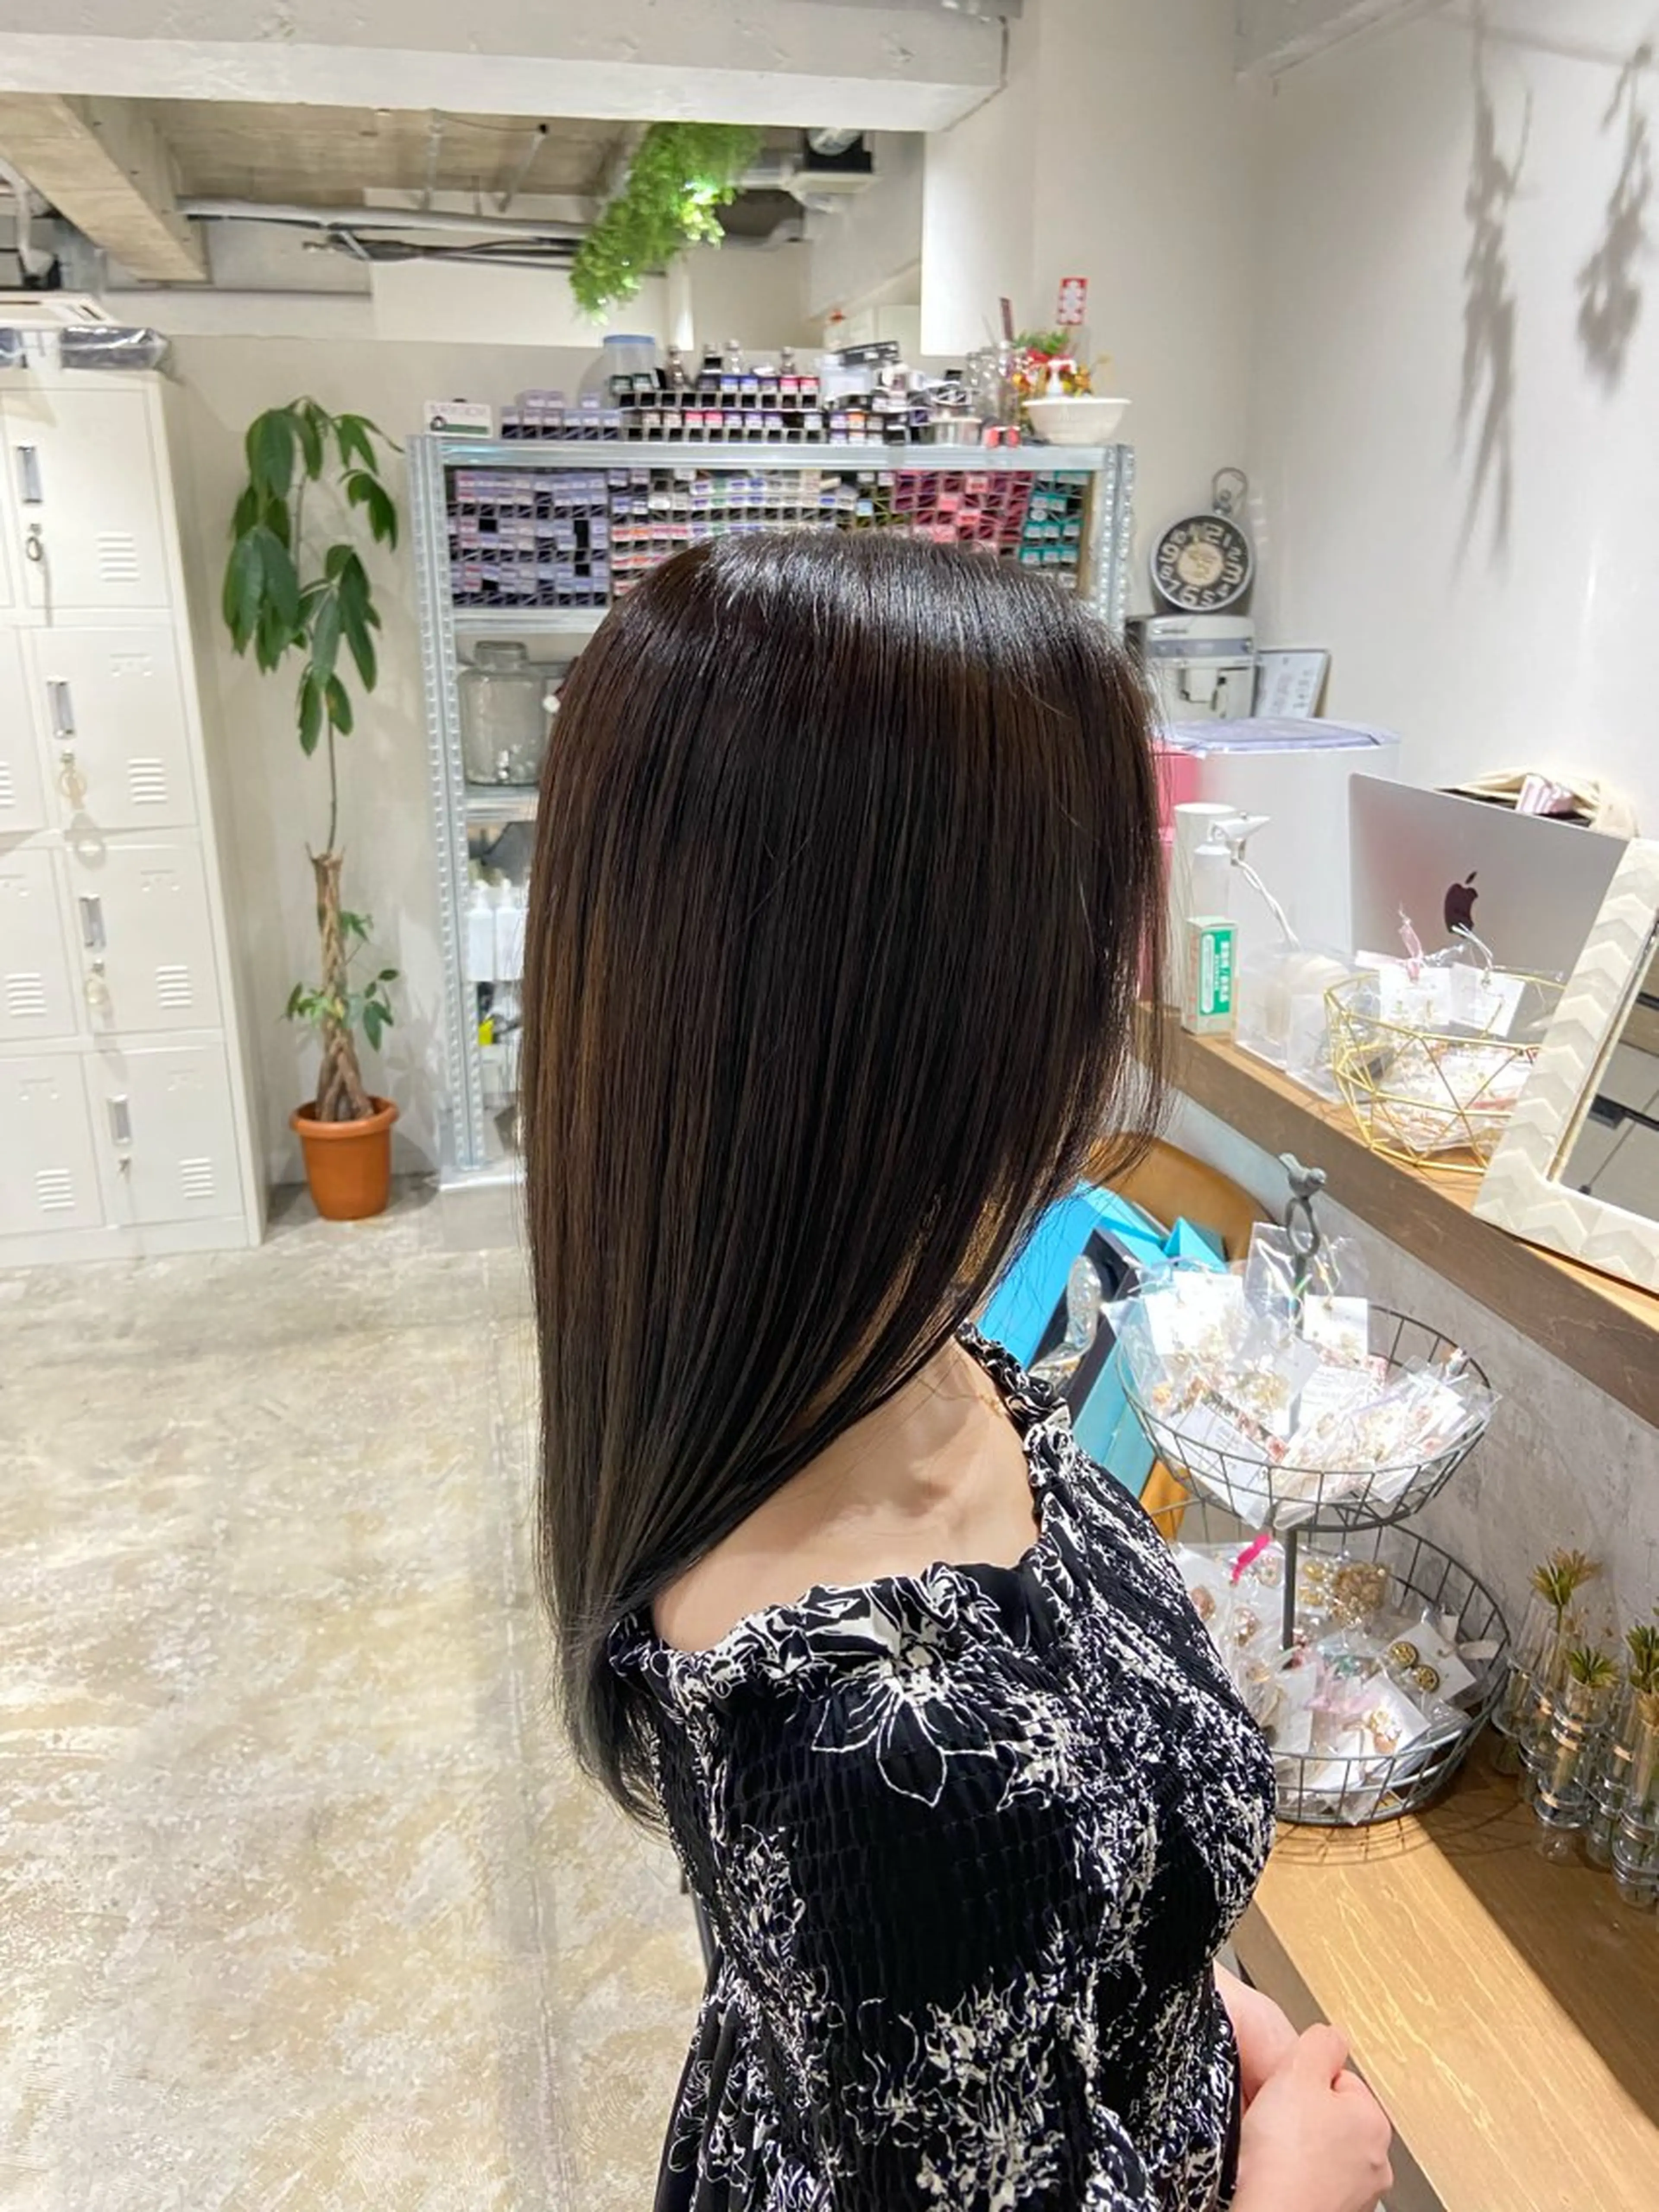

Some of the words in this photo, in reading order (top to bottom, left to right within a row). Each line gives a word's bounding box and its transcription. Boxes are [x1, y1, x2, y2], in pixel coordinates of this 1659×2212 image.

[1158, 543, 1180, 563] 9
[1227, 546, 1242, 562] 2
[1160, 565, 1174, 580] 8
[1221, 561, 1243, 584] 3
[1166, 578, 1182, 593] 7
[1180, 585, 1200, 606] 6
[1200, 589, 1217, 607] 5
